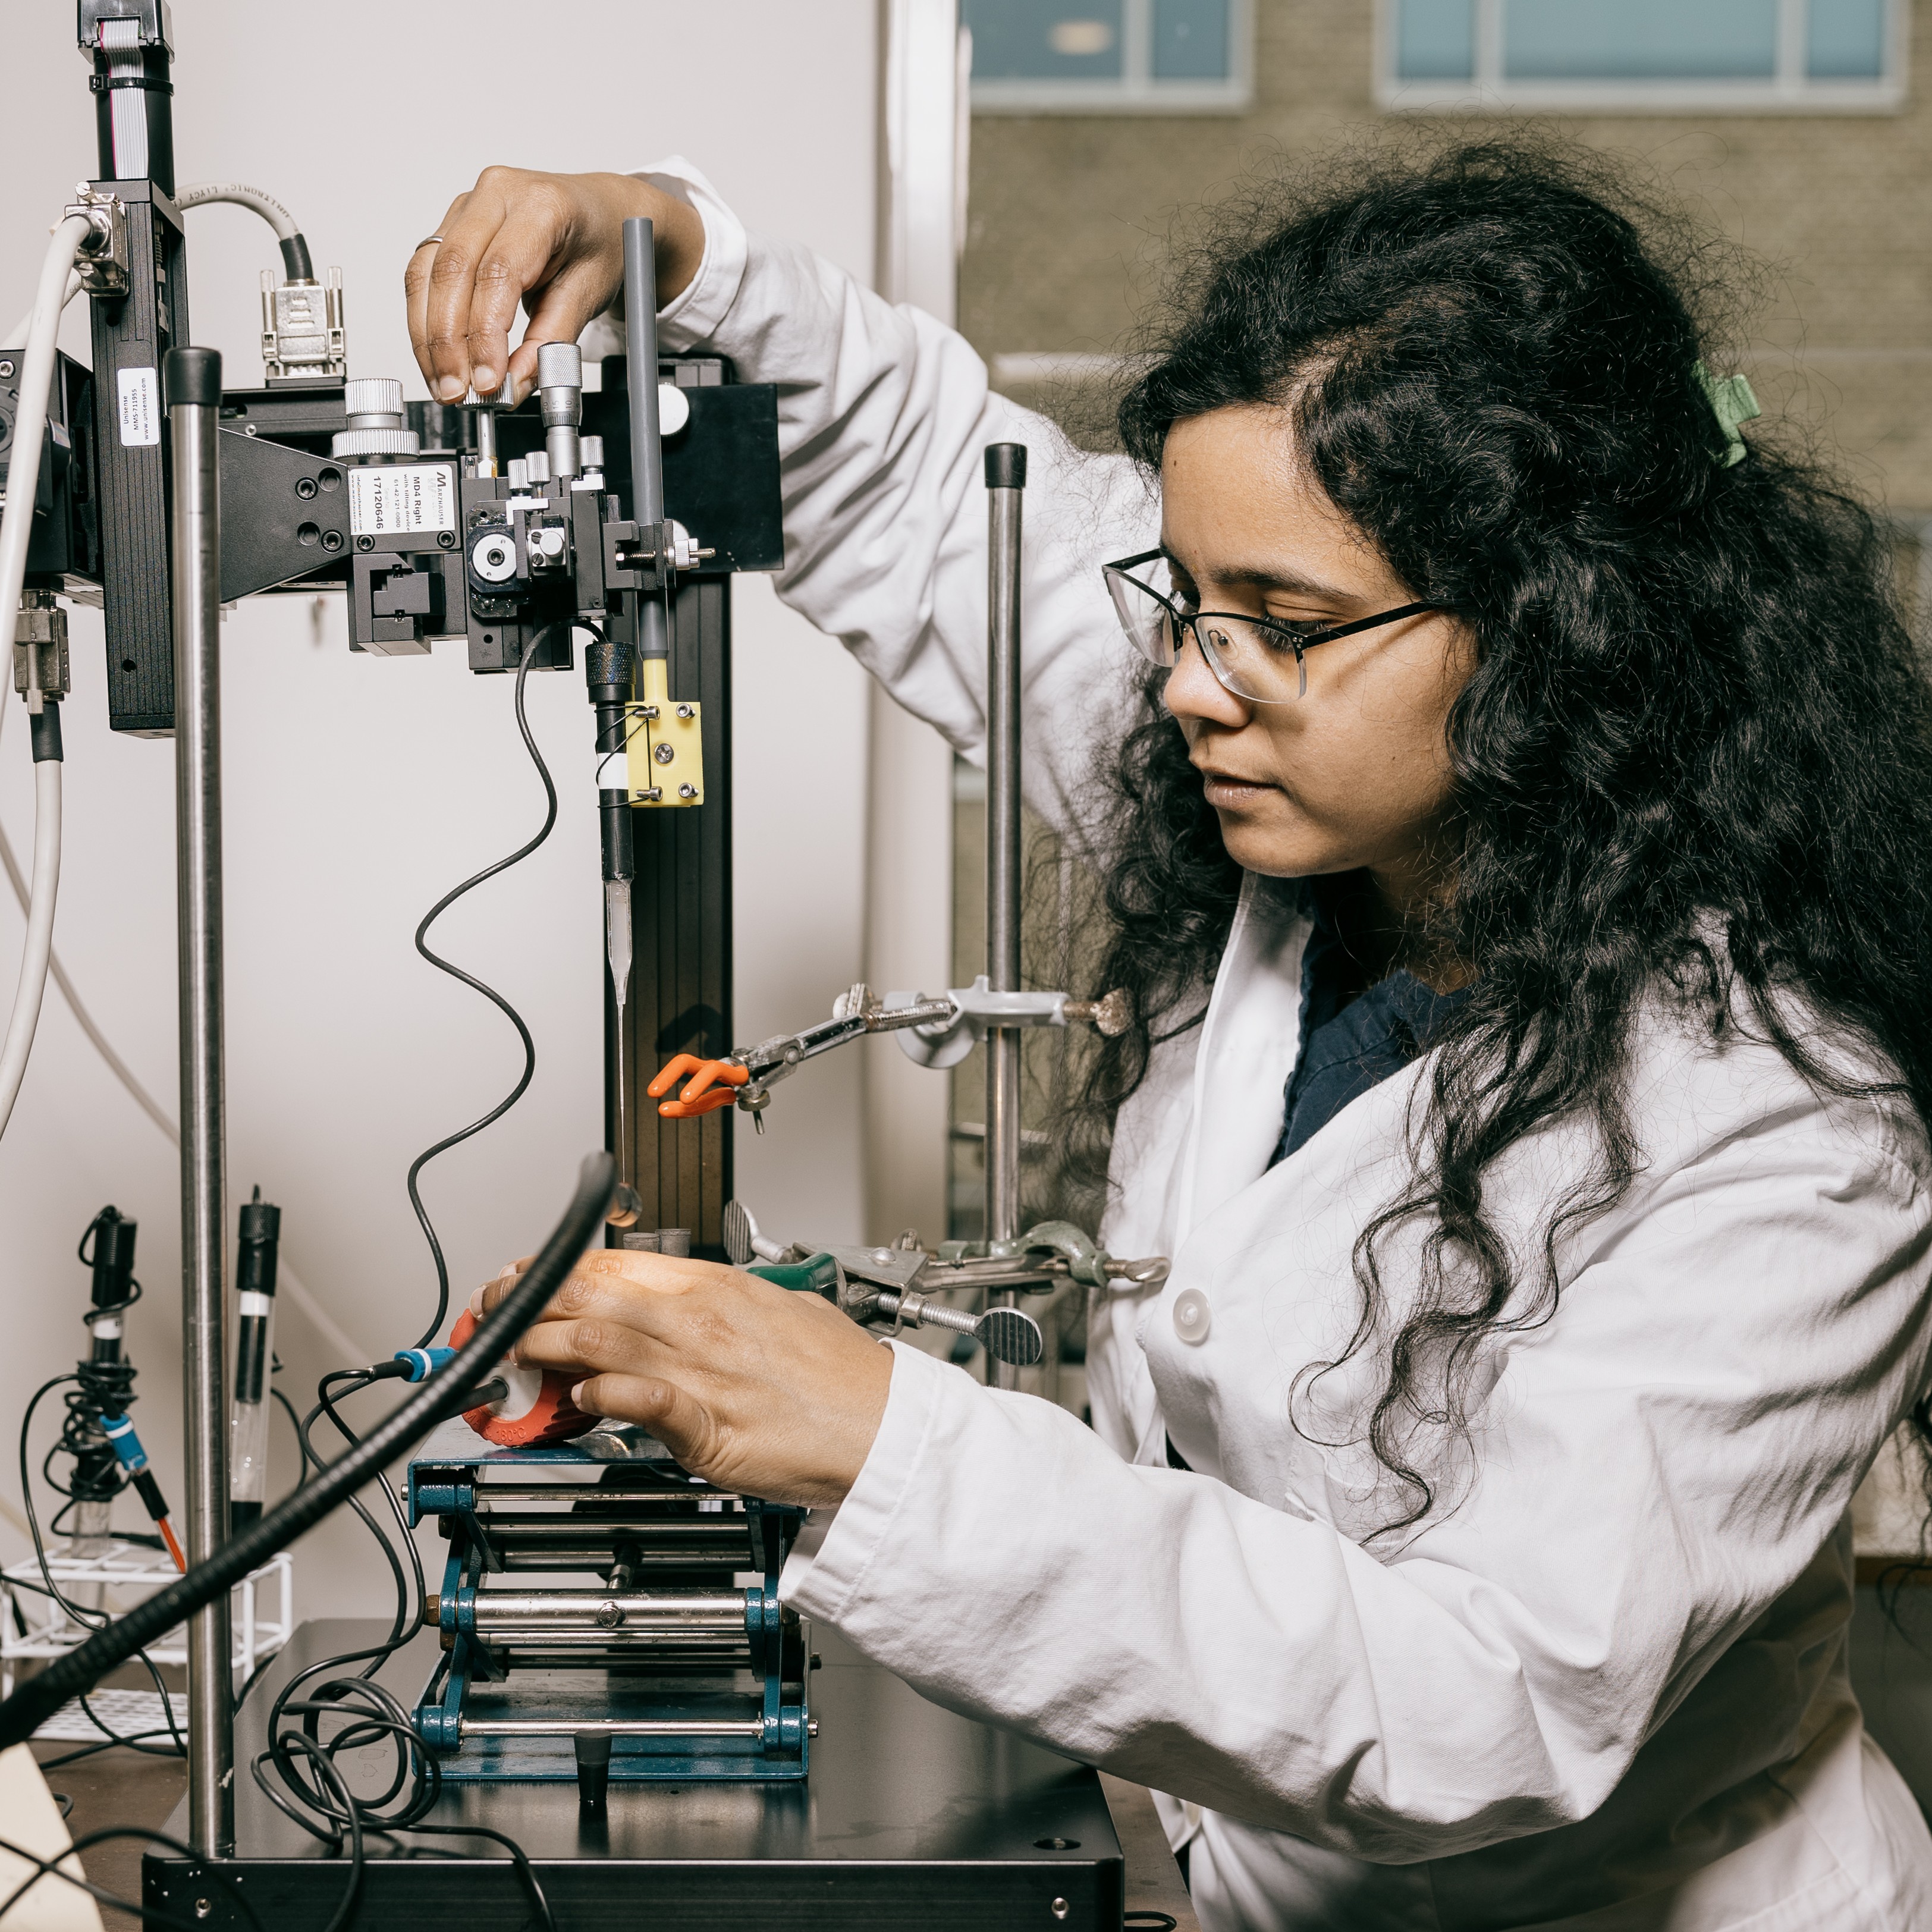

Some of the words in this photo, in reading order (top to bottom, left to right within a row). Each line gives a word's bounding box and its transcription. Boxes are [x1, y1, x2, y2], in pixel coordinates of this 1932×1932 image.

[543, 402, 548, 411] 20
[552, 400, 559, 409] 15
[566, 400, 571, 409] 10
[373, 476, 384, 529] 17120646
[413, 500, 422, 524] Right
